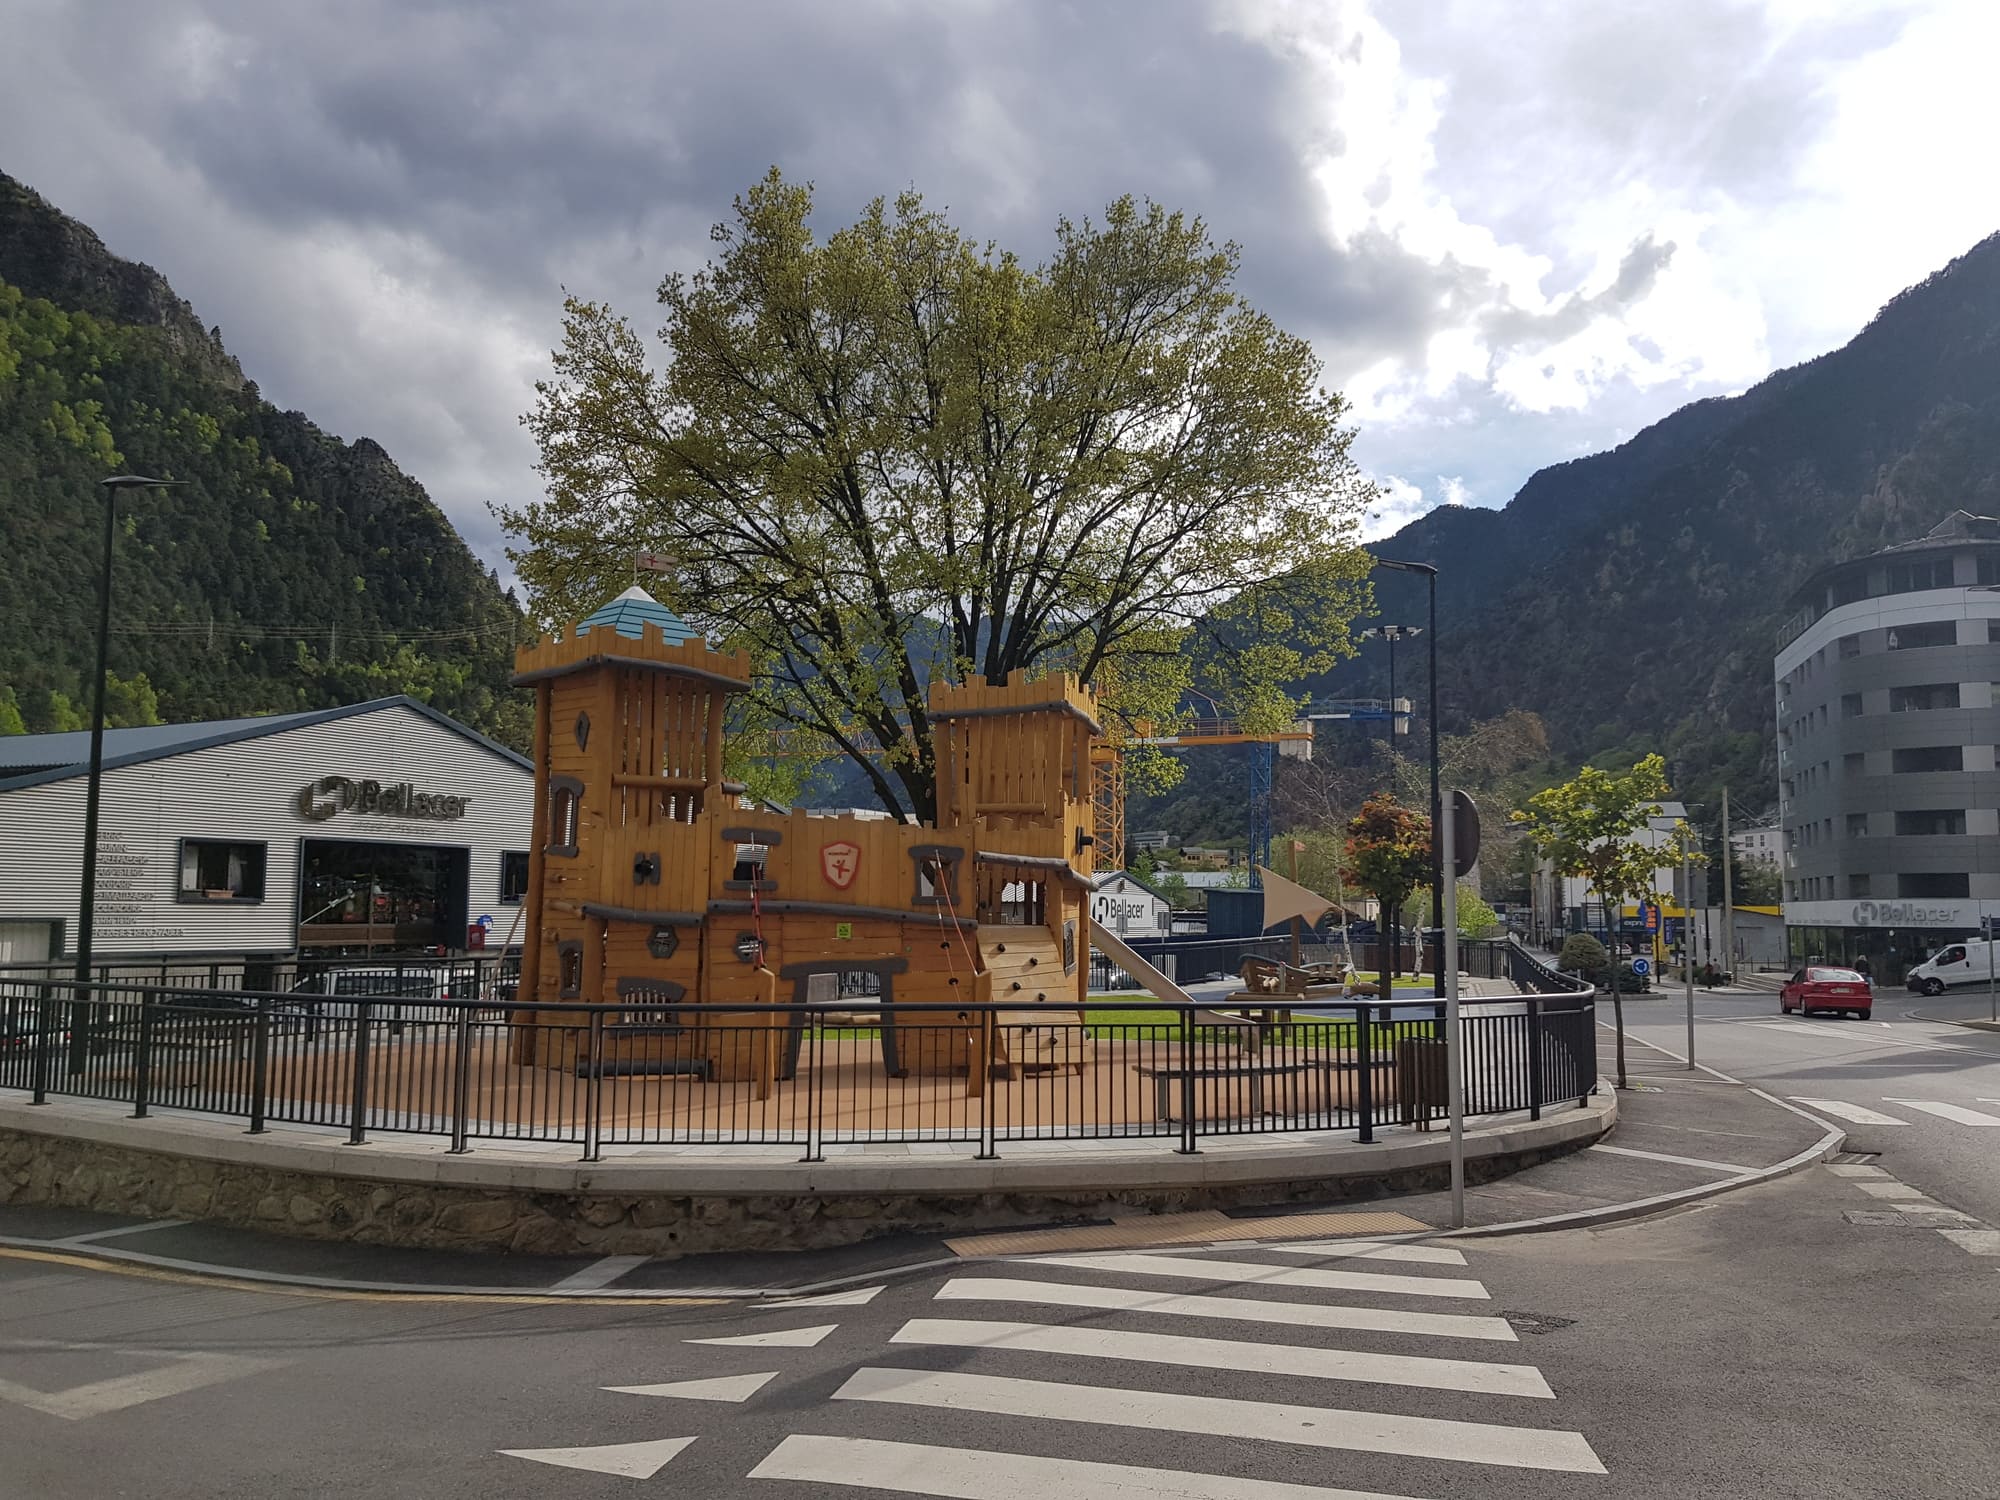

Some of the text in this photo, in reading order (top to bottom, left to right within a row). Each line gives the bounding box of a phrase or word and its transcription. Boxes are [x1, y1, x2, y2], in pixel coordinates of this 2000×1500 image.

[358, 779, 472, 820] Bellacer
[1110, 898, 1145, 919] Bellacer
[1879, 903, 1960, 922] Bellacer
